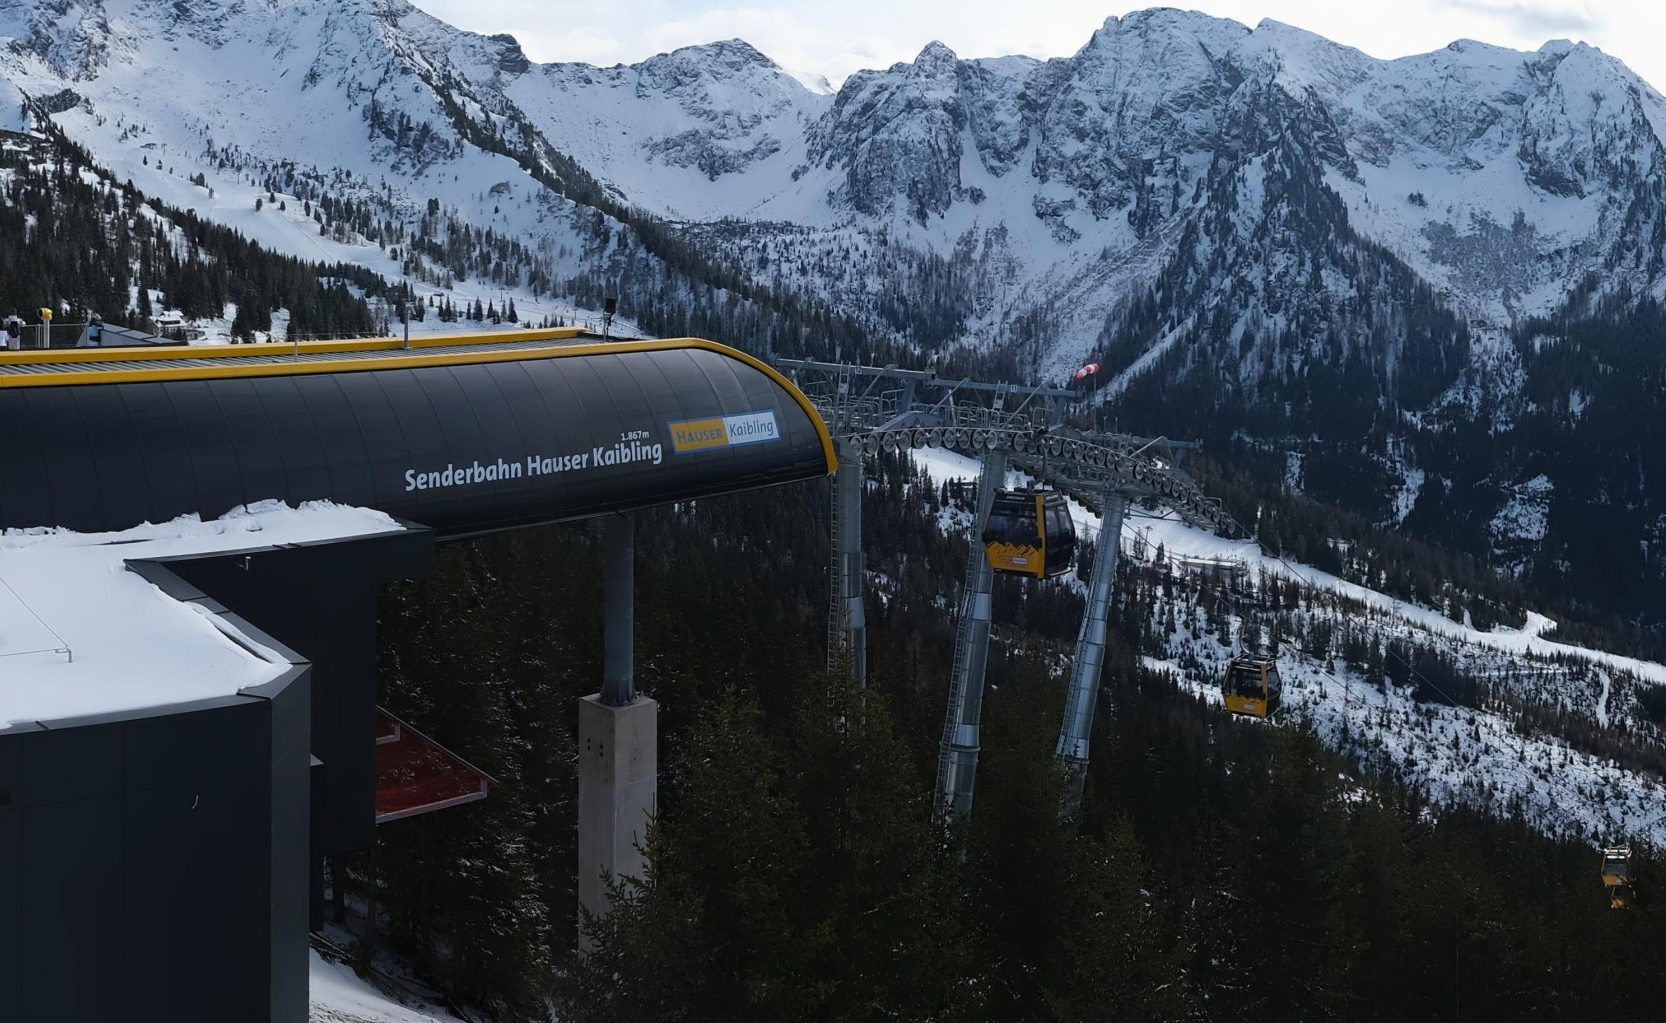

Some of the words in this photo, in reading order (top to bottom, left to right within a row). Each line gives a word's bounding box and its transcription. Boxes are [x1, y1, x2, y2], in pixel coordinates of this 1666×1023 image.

[620, 430, 650, 442] 1.867m
[729, 420, 774, 437] Kaibling
[405, 458, 522, 492] Senderbahn
[527, 453, 589, 477] Hauser
[592, 440, 663, 467] Kaibling
